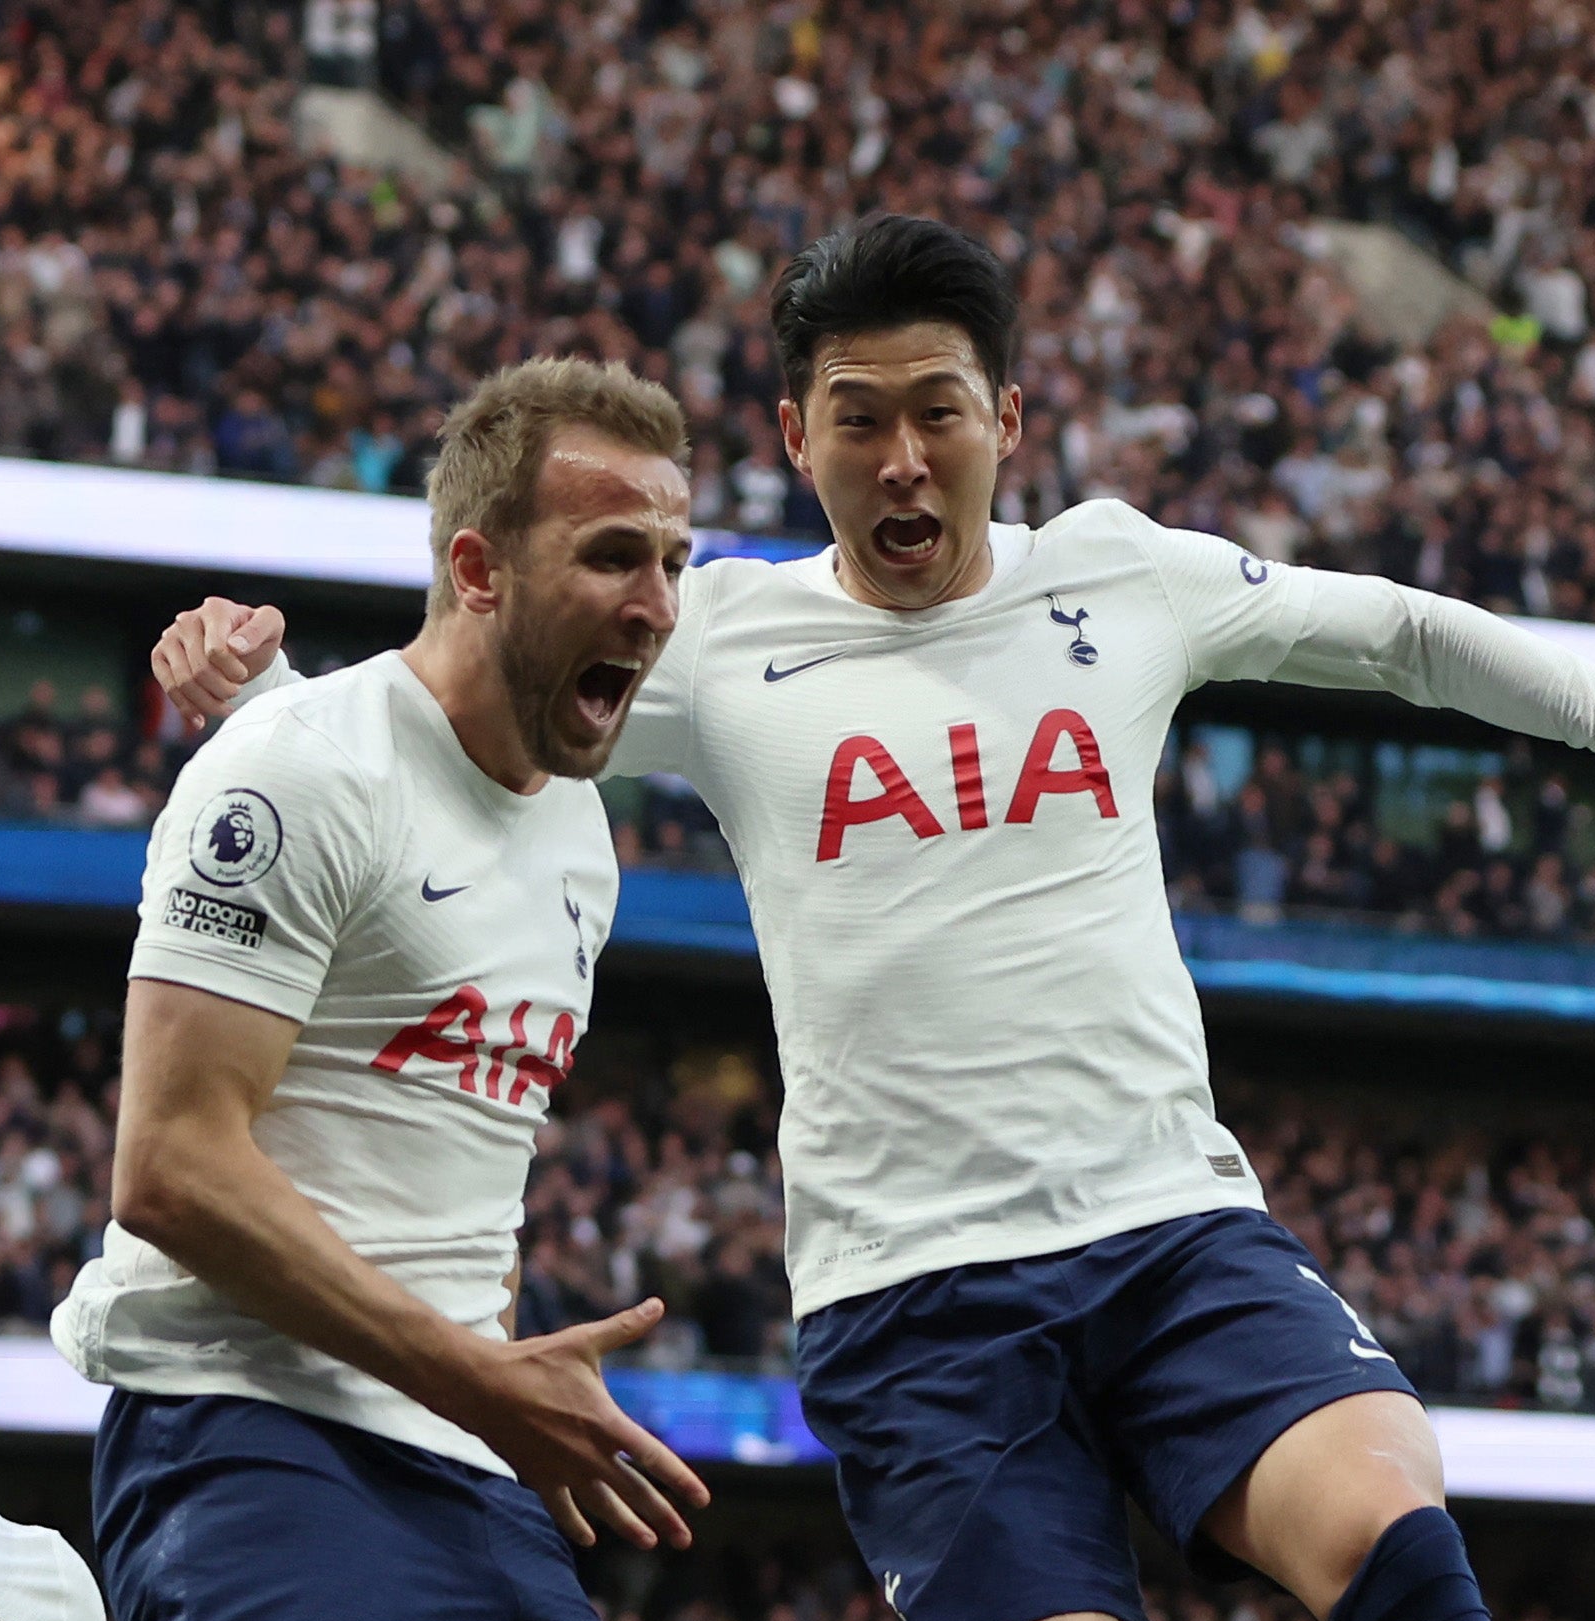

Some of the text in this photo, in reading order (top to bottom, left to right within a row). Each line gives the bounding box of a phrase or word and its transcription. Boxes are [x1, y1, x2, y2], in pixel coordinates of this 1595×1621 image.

[816, 708, 1119, 863] AIA
[169, 887, 255, 930] No room
[190, 915, 261, 949] racism
[370, 984, 575, 1107] AIA
